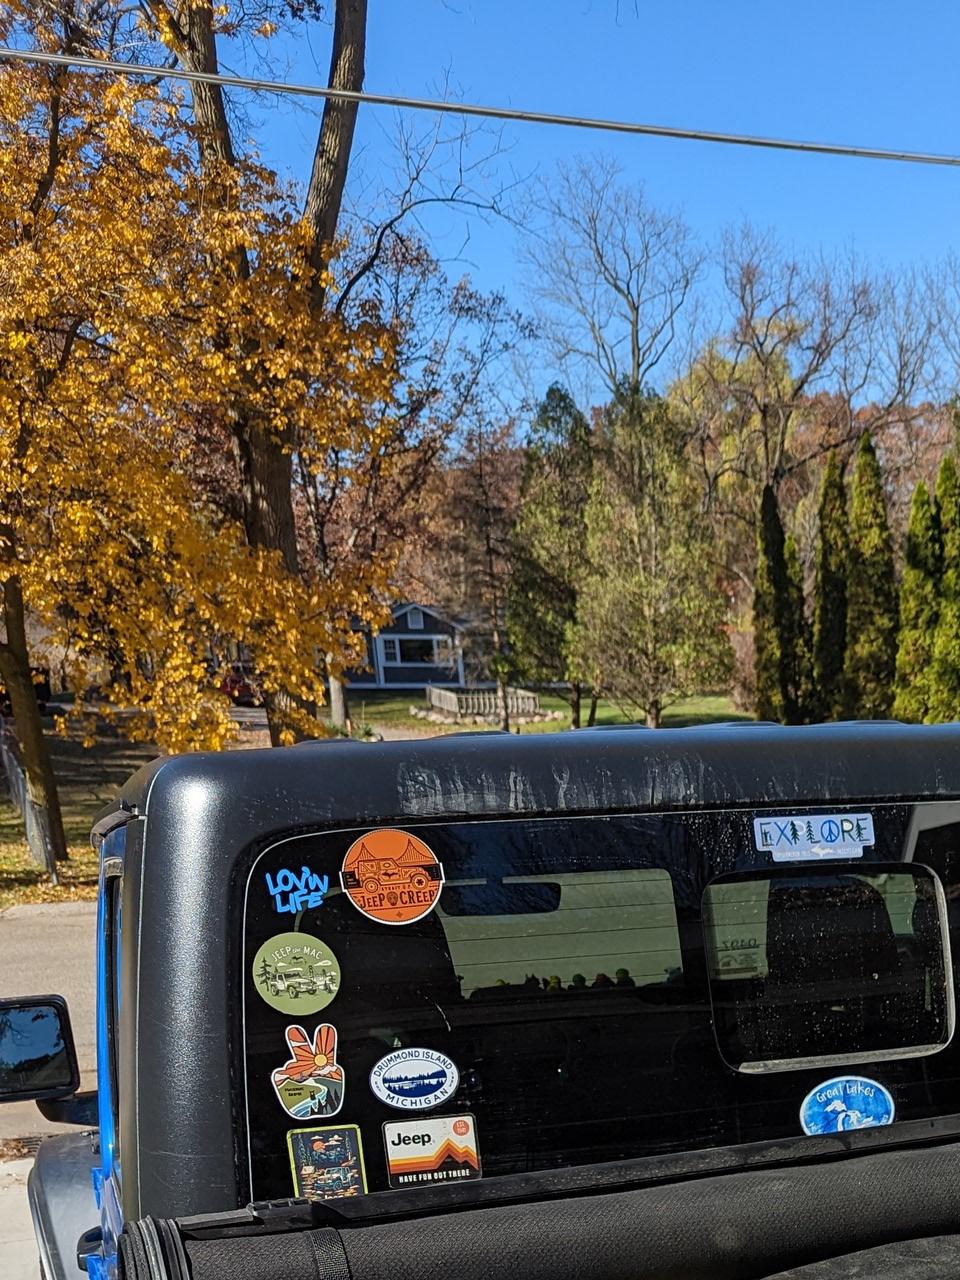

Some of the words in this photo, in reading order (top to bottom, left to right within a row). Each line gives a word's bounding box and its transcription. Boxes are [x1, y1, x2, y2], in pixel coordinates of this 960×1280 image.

[760, 816, 871, 847] EXPLORE
[275, 889, 323, 914] LIFE
[361, 893, 385, 908] JEEP
[400, 889, 434, 905] CREEP
[271, 946, 291, 962] JEEP
[303, 946, 323, 960] MAC
[373, 1050, 421, 1078] DRUMMOND
[422, 1050, 453, 1071] ISLAND
[385, 1087, 449, 1107] MICHIGAN
[846, 1083, 875, 1097] Lakes
[391, 1132, 432, 1147] Jeep
[398, 1175, 418, 1184] HAVE
[418, 1172, 433, 1182] FUN
[433, 1170, 448, 1180] OUT
[448, 1168, 471, 1178] THERE
